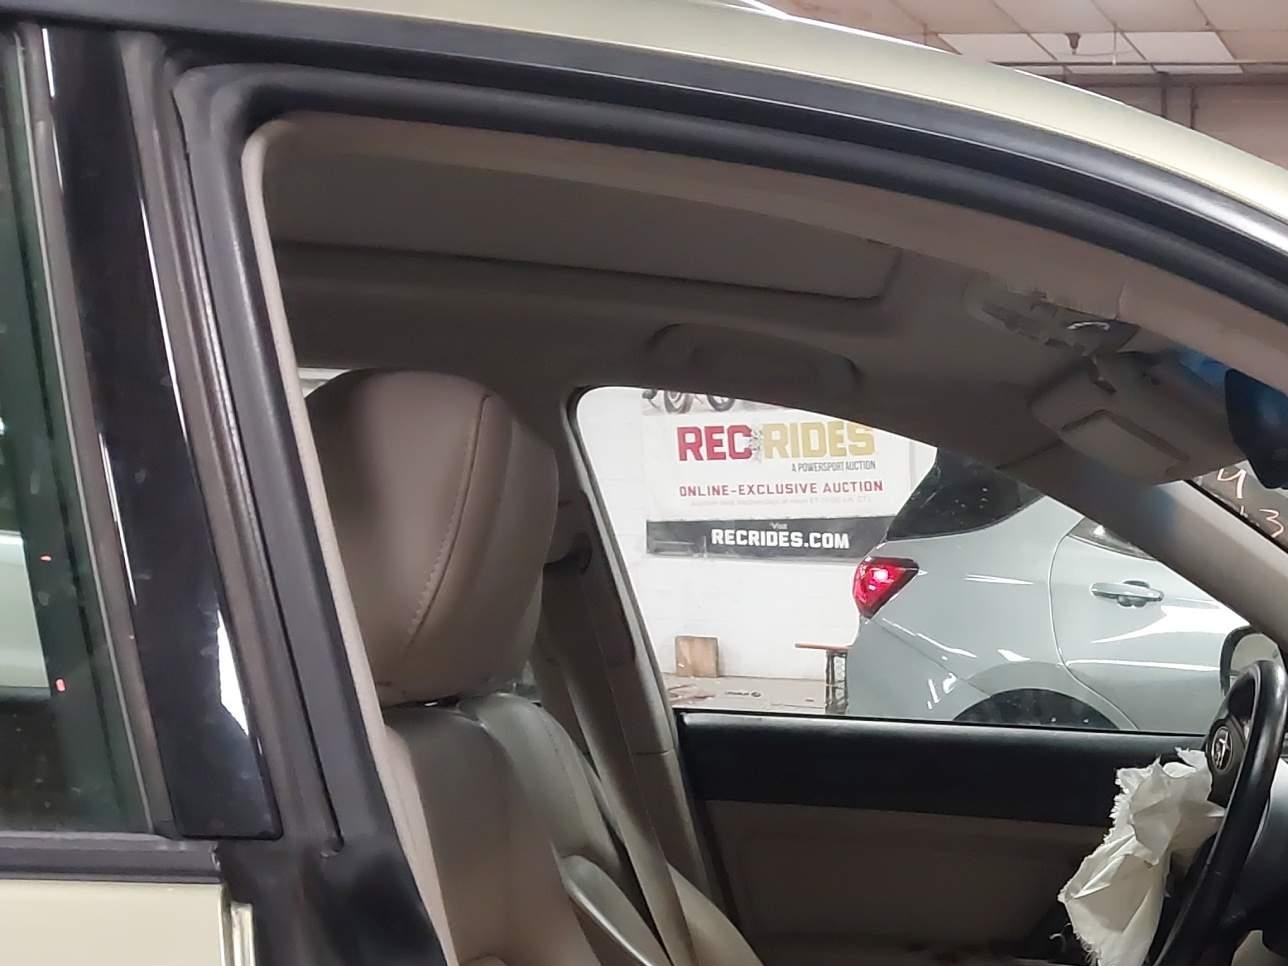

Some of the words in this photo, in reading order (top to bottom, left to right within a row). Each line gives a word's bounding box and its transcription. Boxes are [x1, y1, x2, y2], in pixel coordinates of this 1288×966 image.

[677, 425, 753, 461] REC
[763, 421, 876, 459] RIDES
[791, 463, 797, 472] A
[798, 462, 845, 472] POWERSPORT
[845, 460, 876, 471] AUCTION
[679, 482, 818, 497] ONLINE-EXCLUSIVE
[823, 480, 884, 493] AUCTION
[711, 529, 850, 549] RECRIDES.COM
